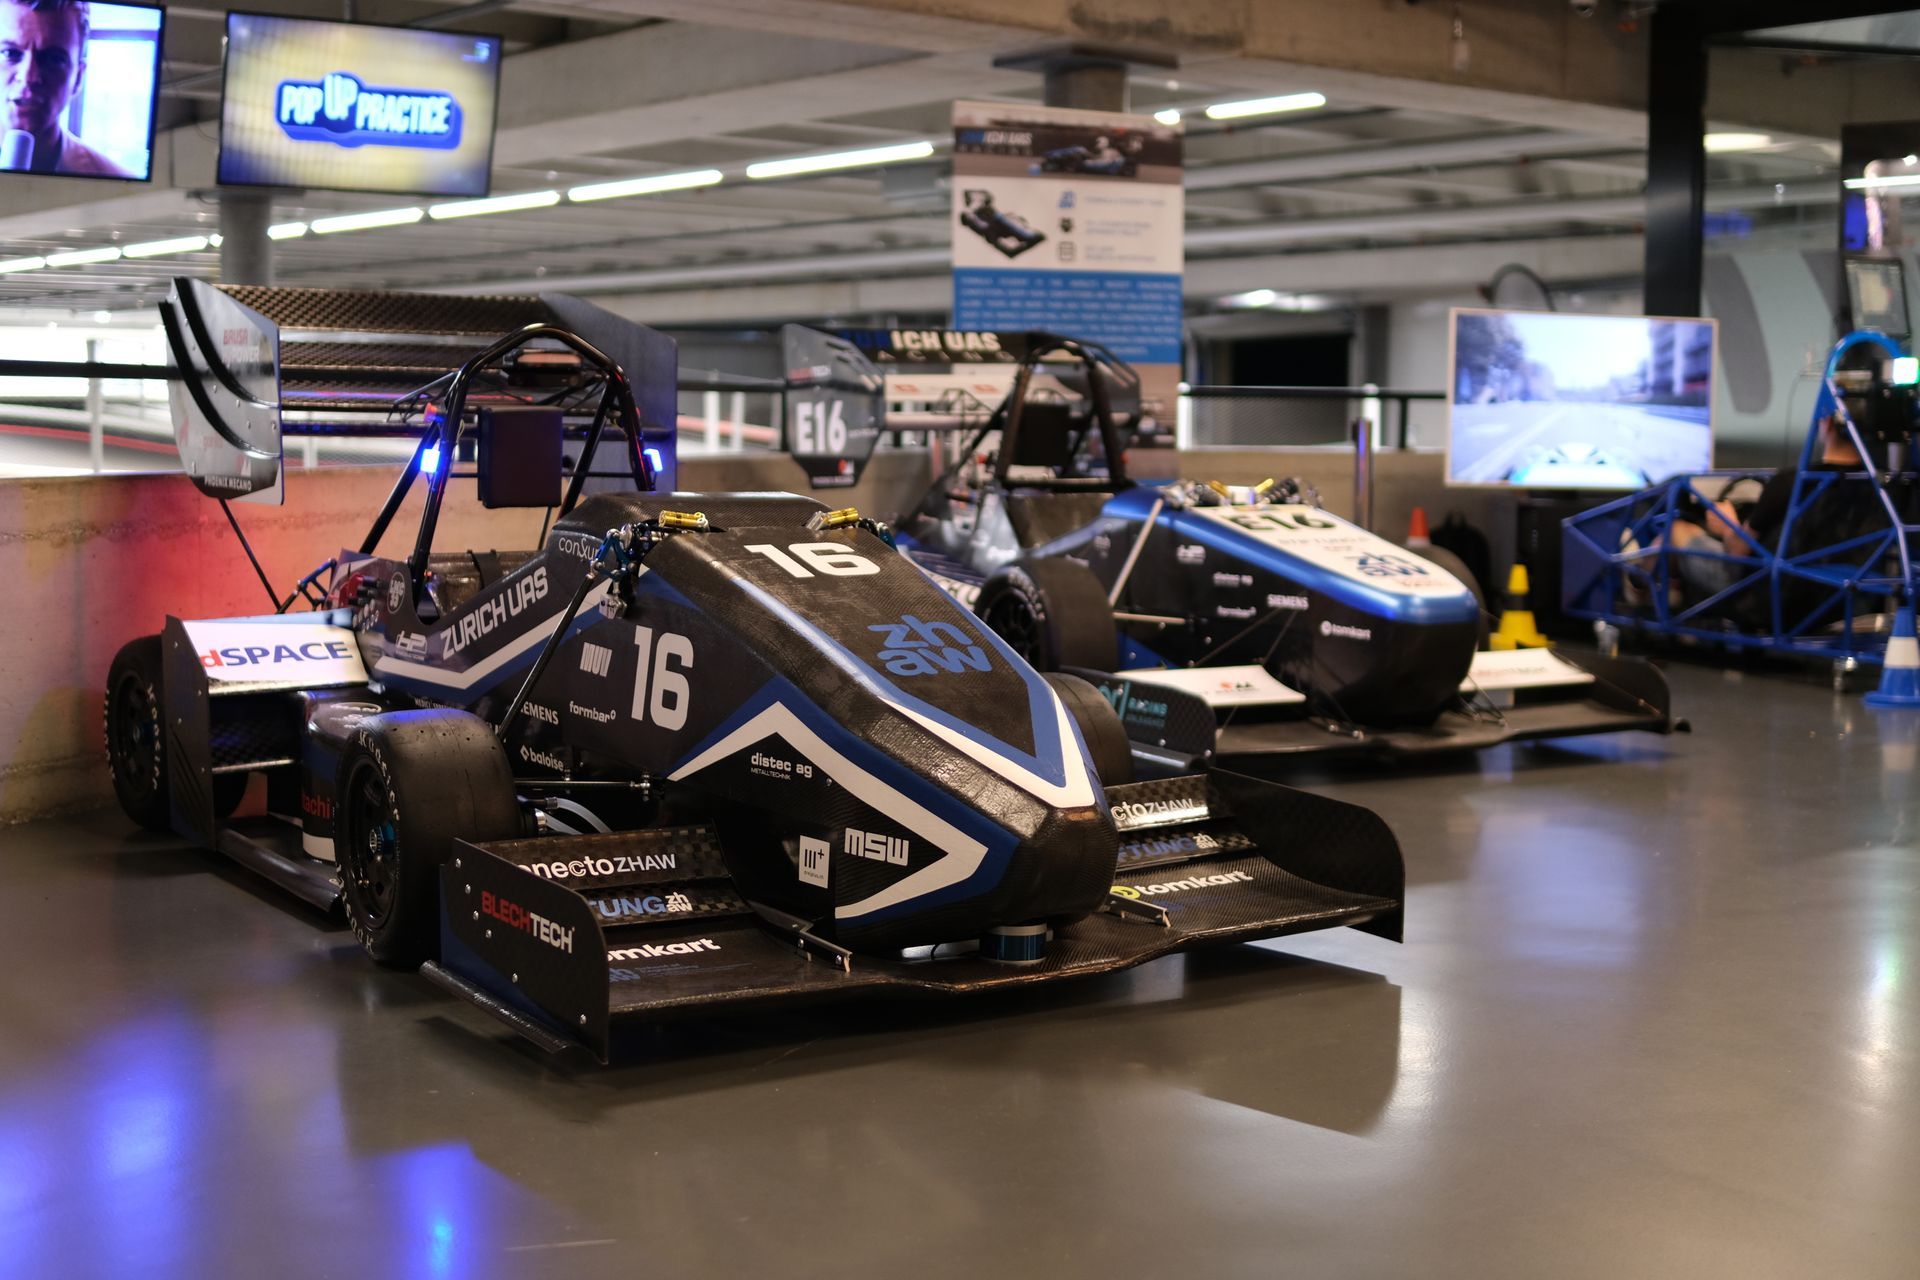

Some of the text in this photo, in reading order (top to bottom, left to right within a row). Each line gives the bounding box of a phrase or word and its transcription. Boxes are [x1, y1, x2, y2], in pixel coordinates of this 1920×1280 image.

[280, 74, 451, 134] POP UP PRACTICE
[943, 331, 1001, 350] UAS
[796, 399, 847, 454] E16
[744, 542, 881, 578] 16
[440, 593, 507, 660] ZURICH
[507, 566, 549, 617] UAS
[1267, 593, 1309, 611] SIEMENS
[200, 640, 353, 668] dSPACE
[631, 625, 695, 732] 16
[522, 701, 559, 725] EMENS
[530, 747, 564, 772] baloise
[751, 753, 813, 779] distec ag
[844, 827, 910, 867] MSW
[1134, 870, 1254, 896] tomkart
[482, 890, 573, 954] BLECHTECH
